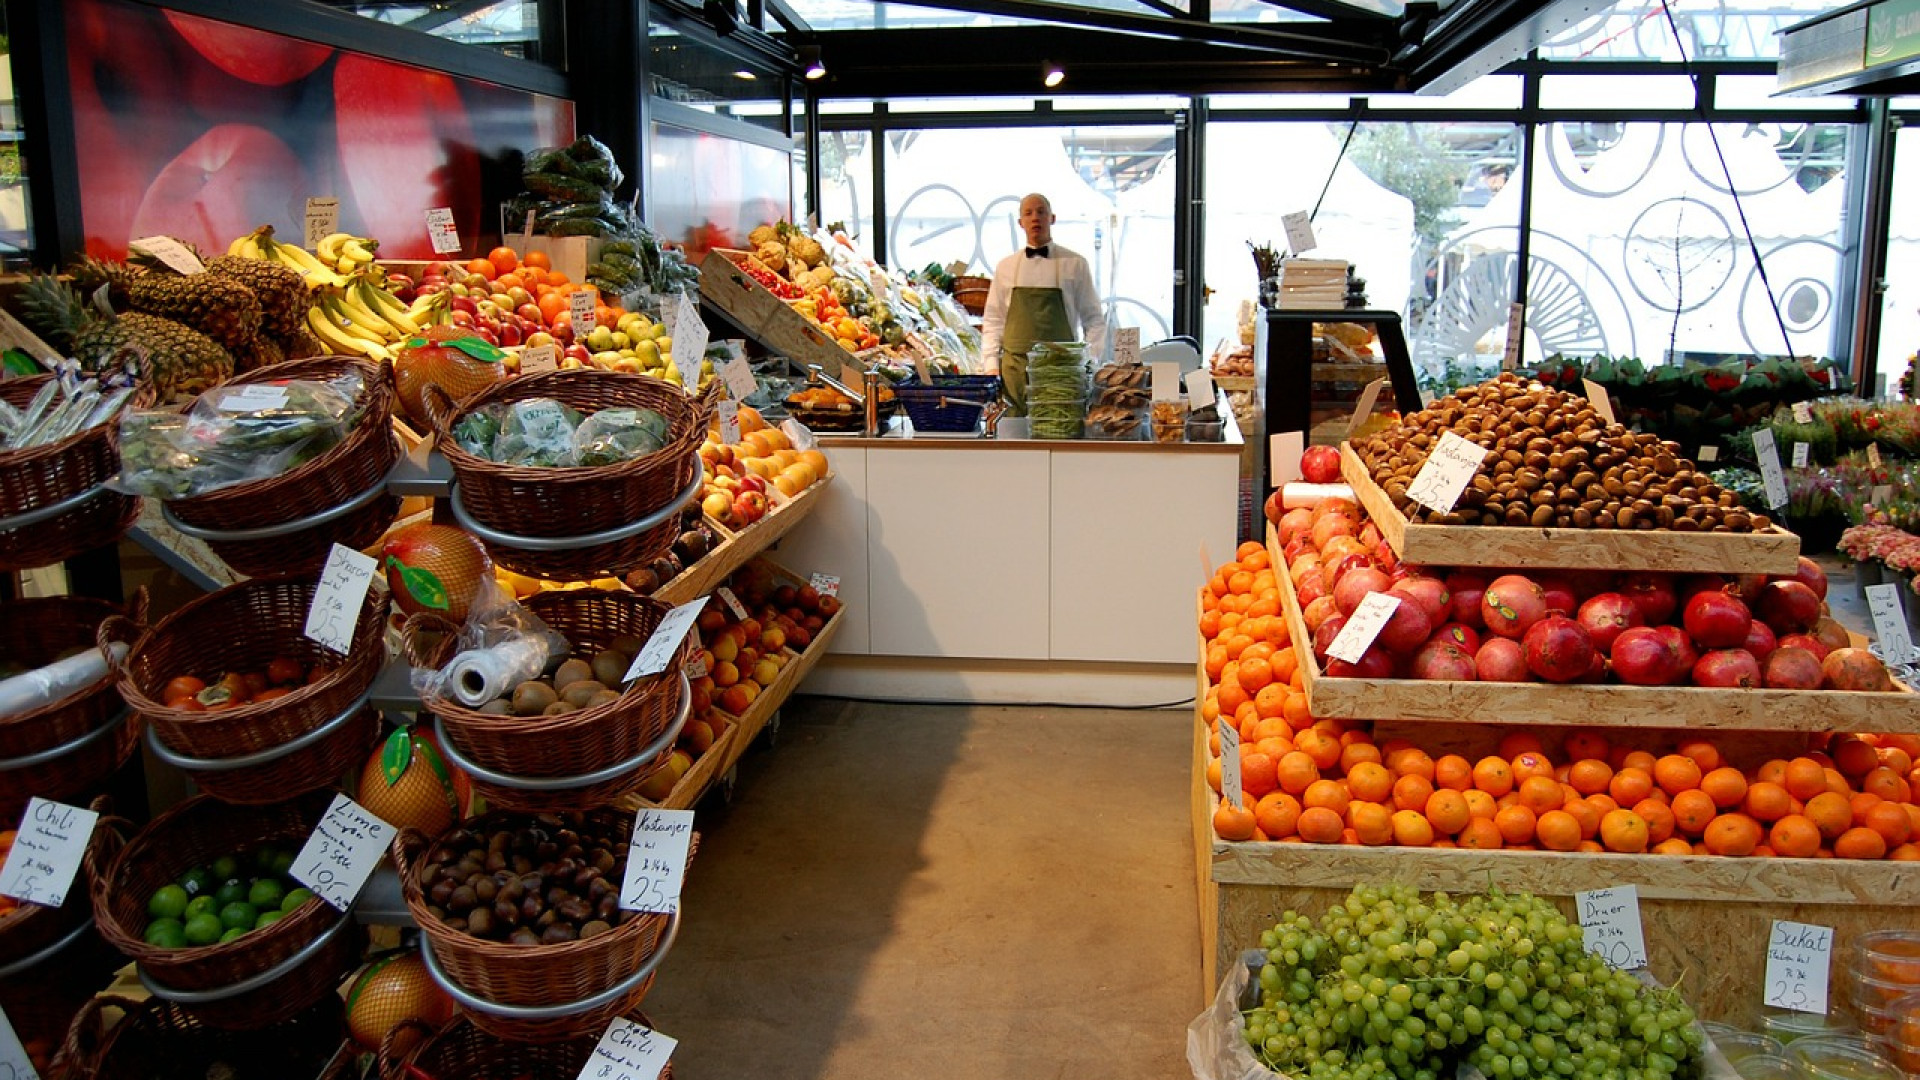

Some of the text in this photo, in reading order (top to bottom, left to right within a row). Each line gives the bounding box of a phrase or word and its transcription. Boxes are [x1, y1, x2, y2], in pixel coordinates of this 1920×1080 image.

[330, 548, 370, 578] Sharon
[35, 802, 76, 830] Chili
[335, 800, 382, 839] Lime
[320, 841, 329, 854] 3
[1586, 901, 1627, 919] Druer
[1771, 921, 1828, 951] Sukat
[610, 1028, 656, 1055] Chili
